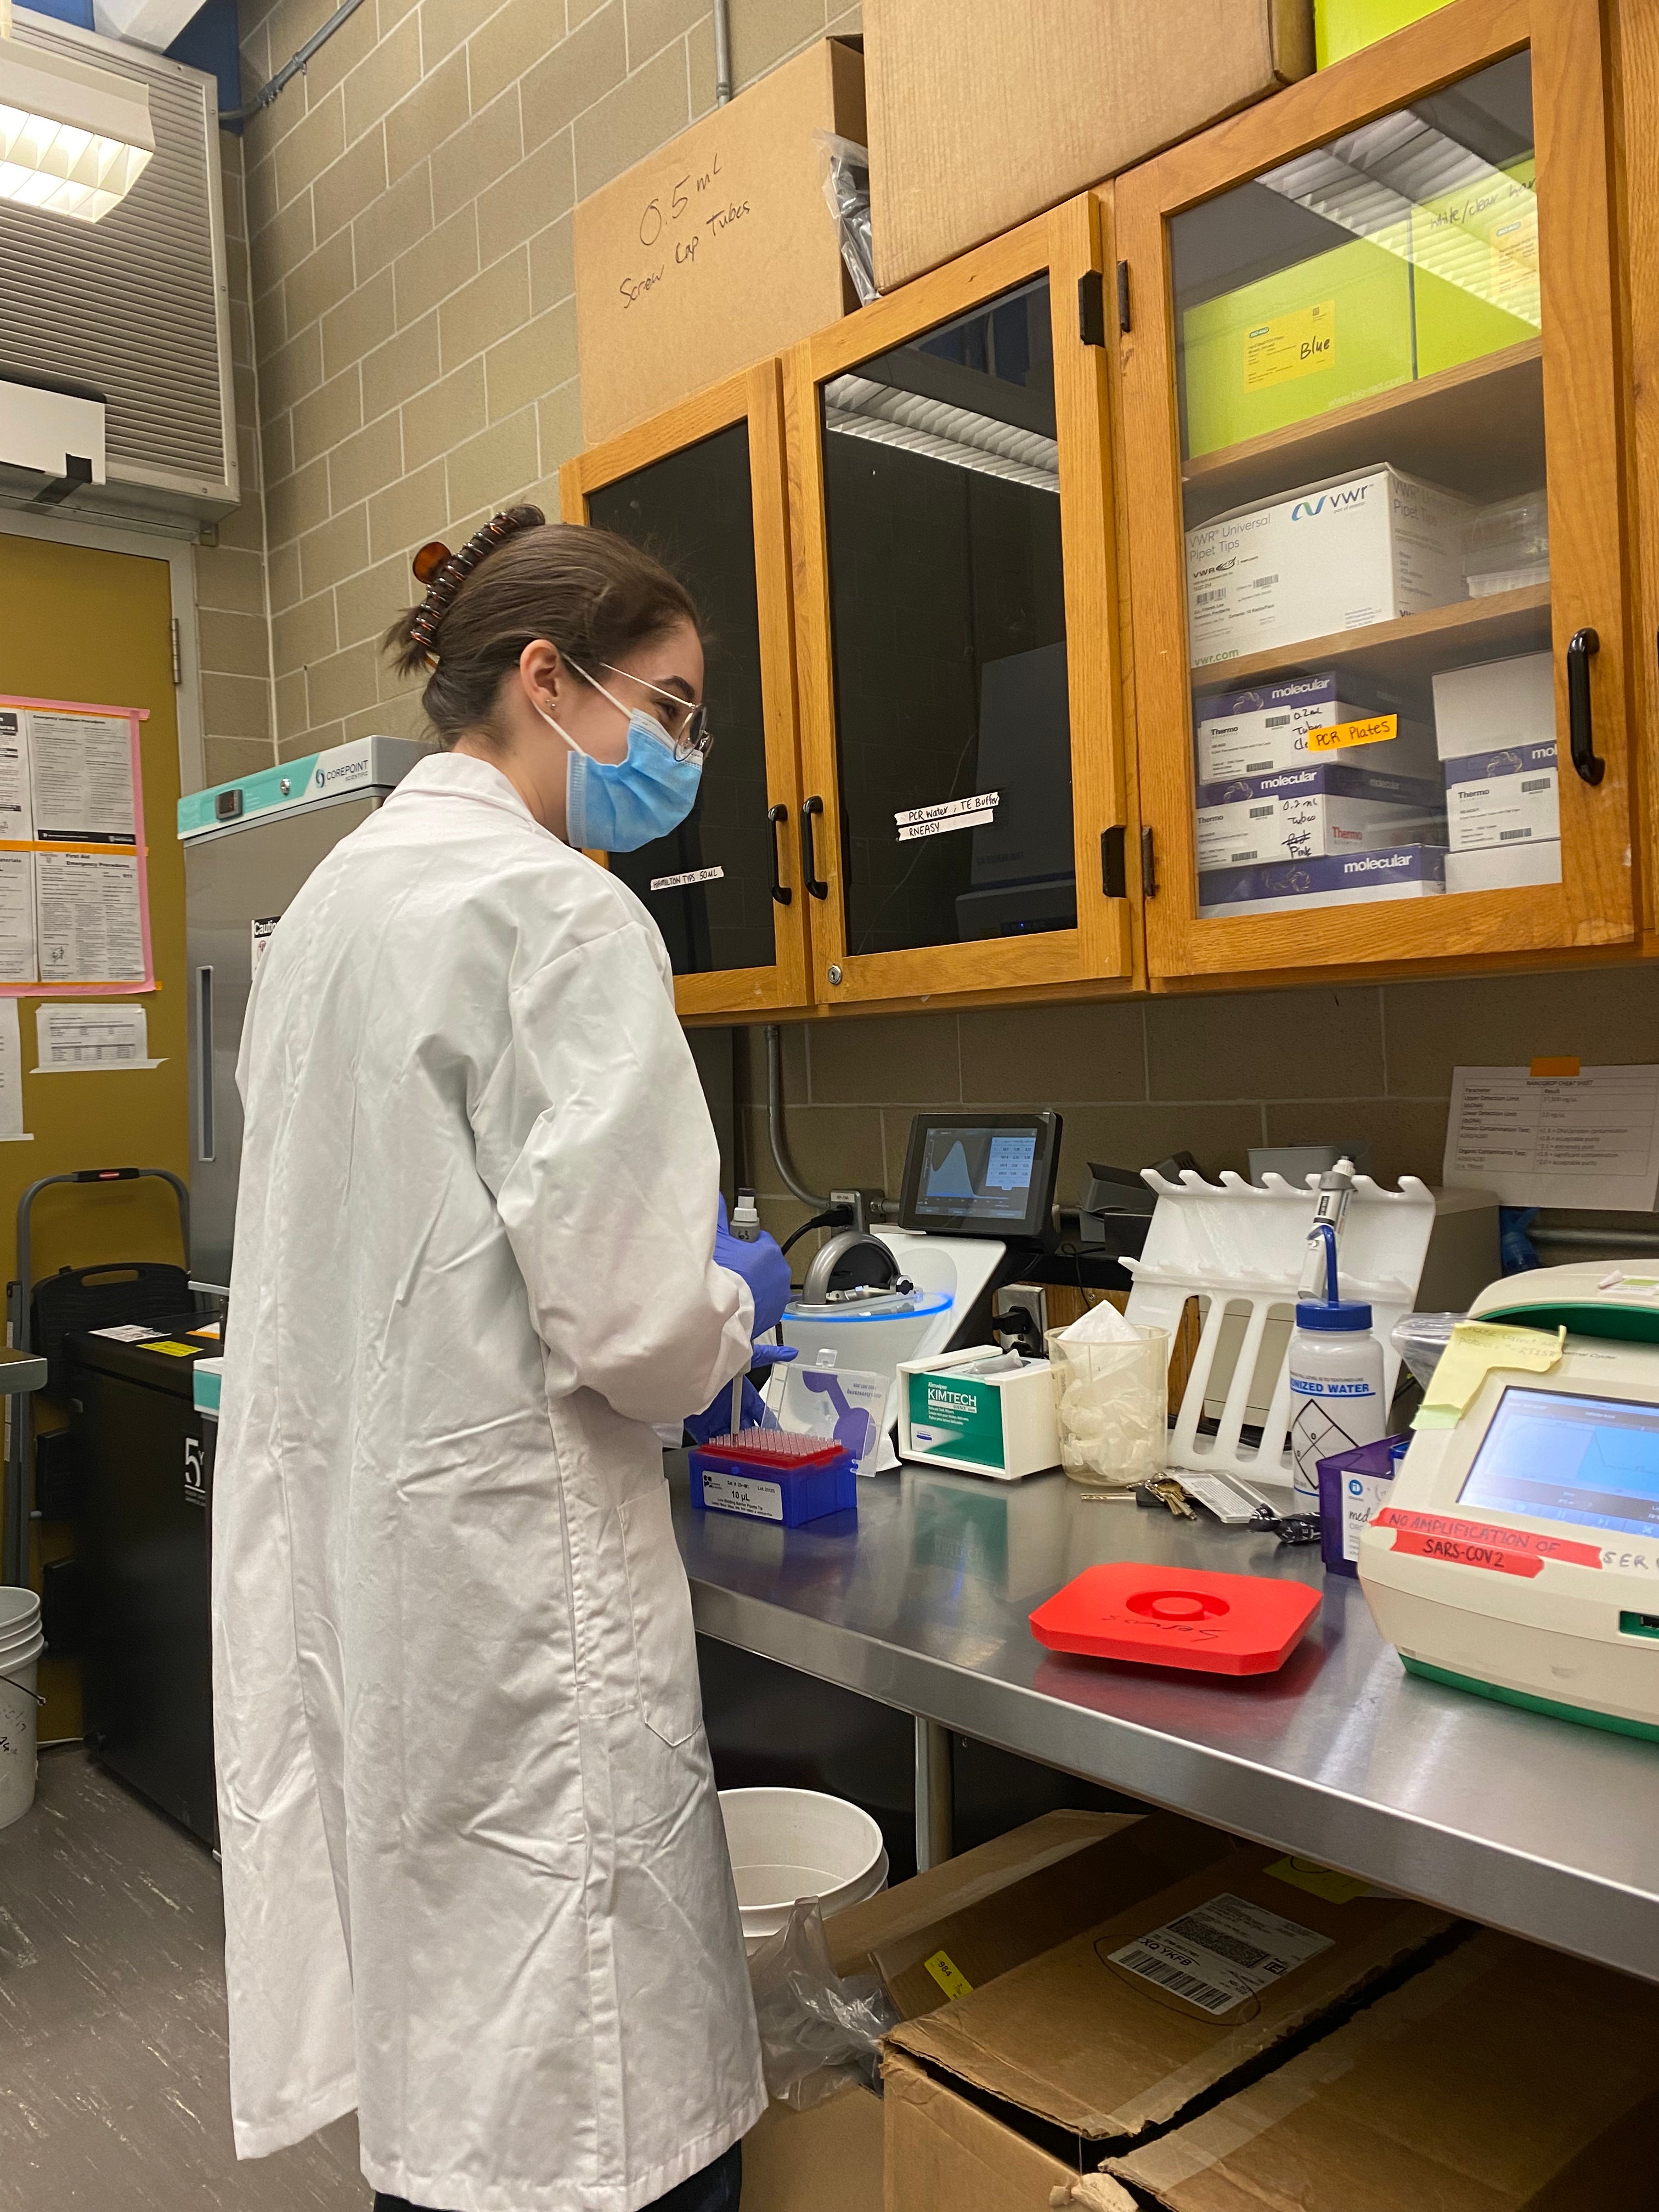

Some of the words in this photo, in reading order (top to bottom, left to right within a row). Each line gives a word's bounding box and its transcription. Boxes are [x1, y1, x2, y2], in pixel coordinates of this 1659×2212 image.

[620, 264, 664, 308] Screw
[675, 236, 698, 264] Cap
[706, 201, 751, 236] Tubes
[1300, 335, 1330, 360] Blue
[1222, 513, 1271, 537] Universal
[1190, 545, 1216, 562] Pipet
[1219, 539, 1240, 552] Tips
[1193, 567, 1215, 578] VWR
[1195, 649, 1239, 665] vwr.com
[1272, 679, 1329, 699] molecular
[1211, 726, 1238, 735] Thermo
[1316, 731, 1341, 747] PCR
[1349, 721, 1390, 740] Plates
[327, 760, 368, 780] COREPOINT
[1261, 772, 1317, 789] molecular
[1458, 789, 1489, 799] Thermo
[909, 811, 924, 821] PCR
[926, 806, 948, 818] Water
[961, 799, 972, 810] TE
[1198, 815, 1223, 823] Thermo
[909, 822, 940, 837] RNEASY
[1332, 826, 1363, 840] Thermo
[1344, 854, 1413, 873] molecular
[928, 1388, 977, 1407] KIMTECH
[1327, 1384, 1369, 1393] WATER
[732, 1490, 740, 1499] 10
[1389, 1513, 1408, 1527] NO
[1410, 1516, 1531, 1549] AMPLIFICATION
[1535, 1540, 1561, 1553] OF
[1602, 1551, 1659, 1570] SER
[1141, 1938, 1159, 1950] XQ
[1160, 1947, 1193, 1966] YKFB
[938, 1961, 952, 1977] 984
